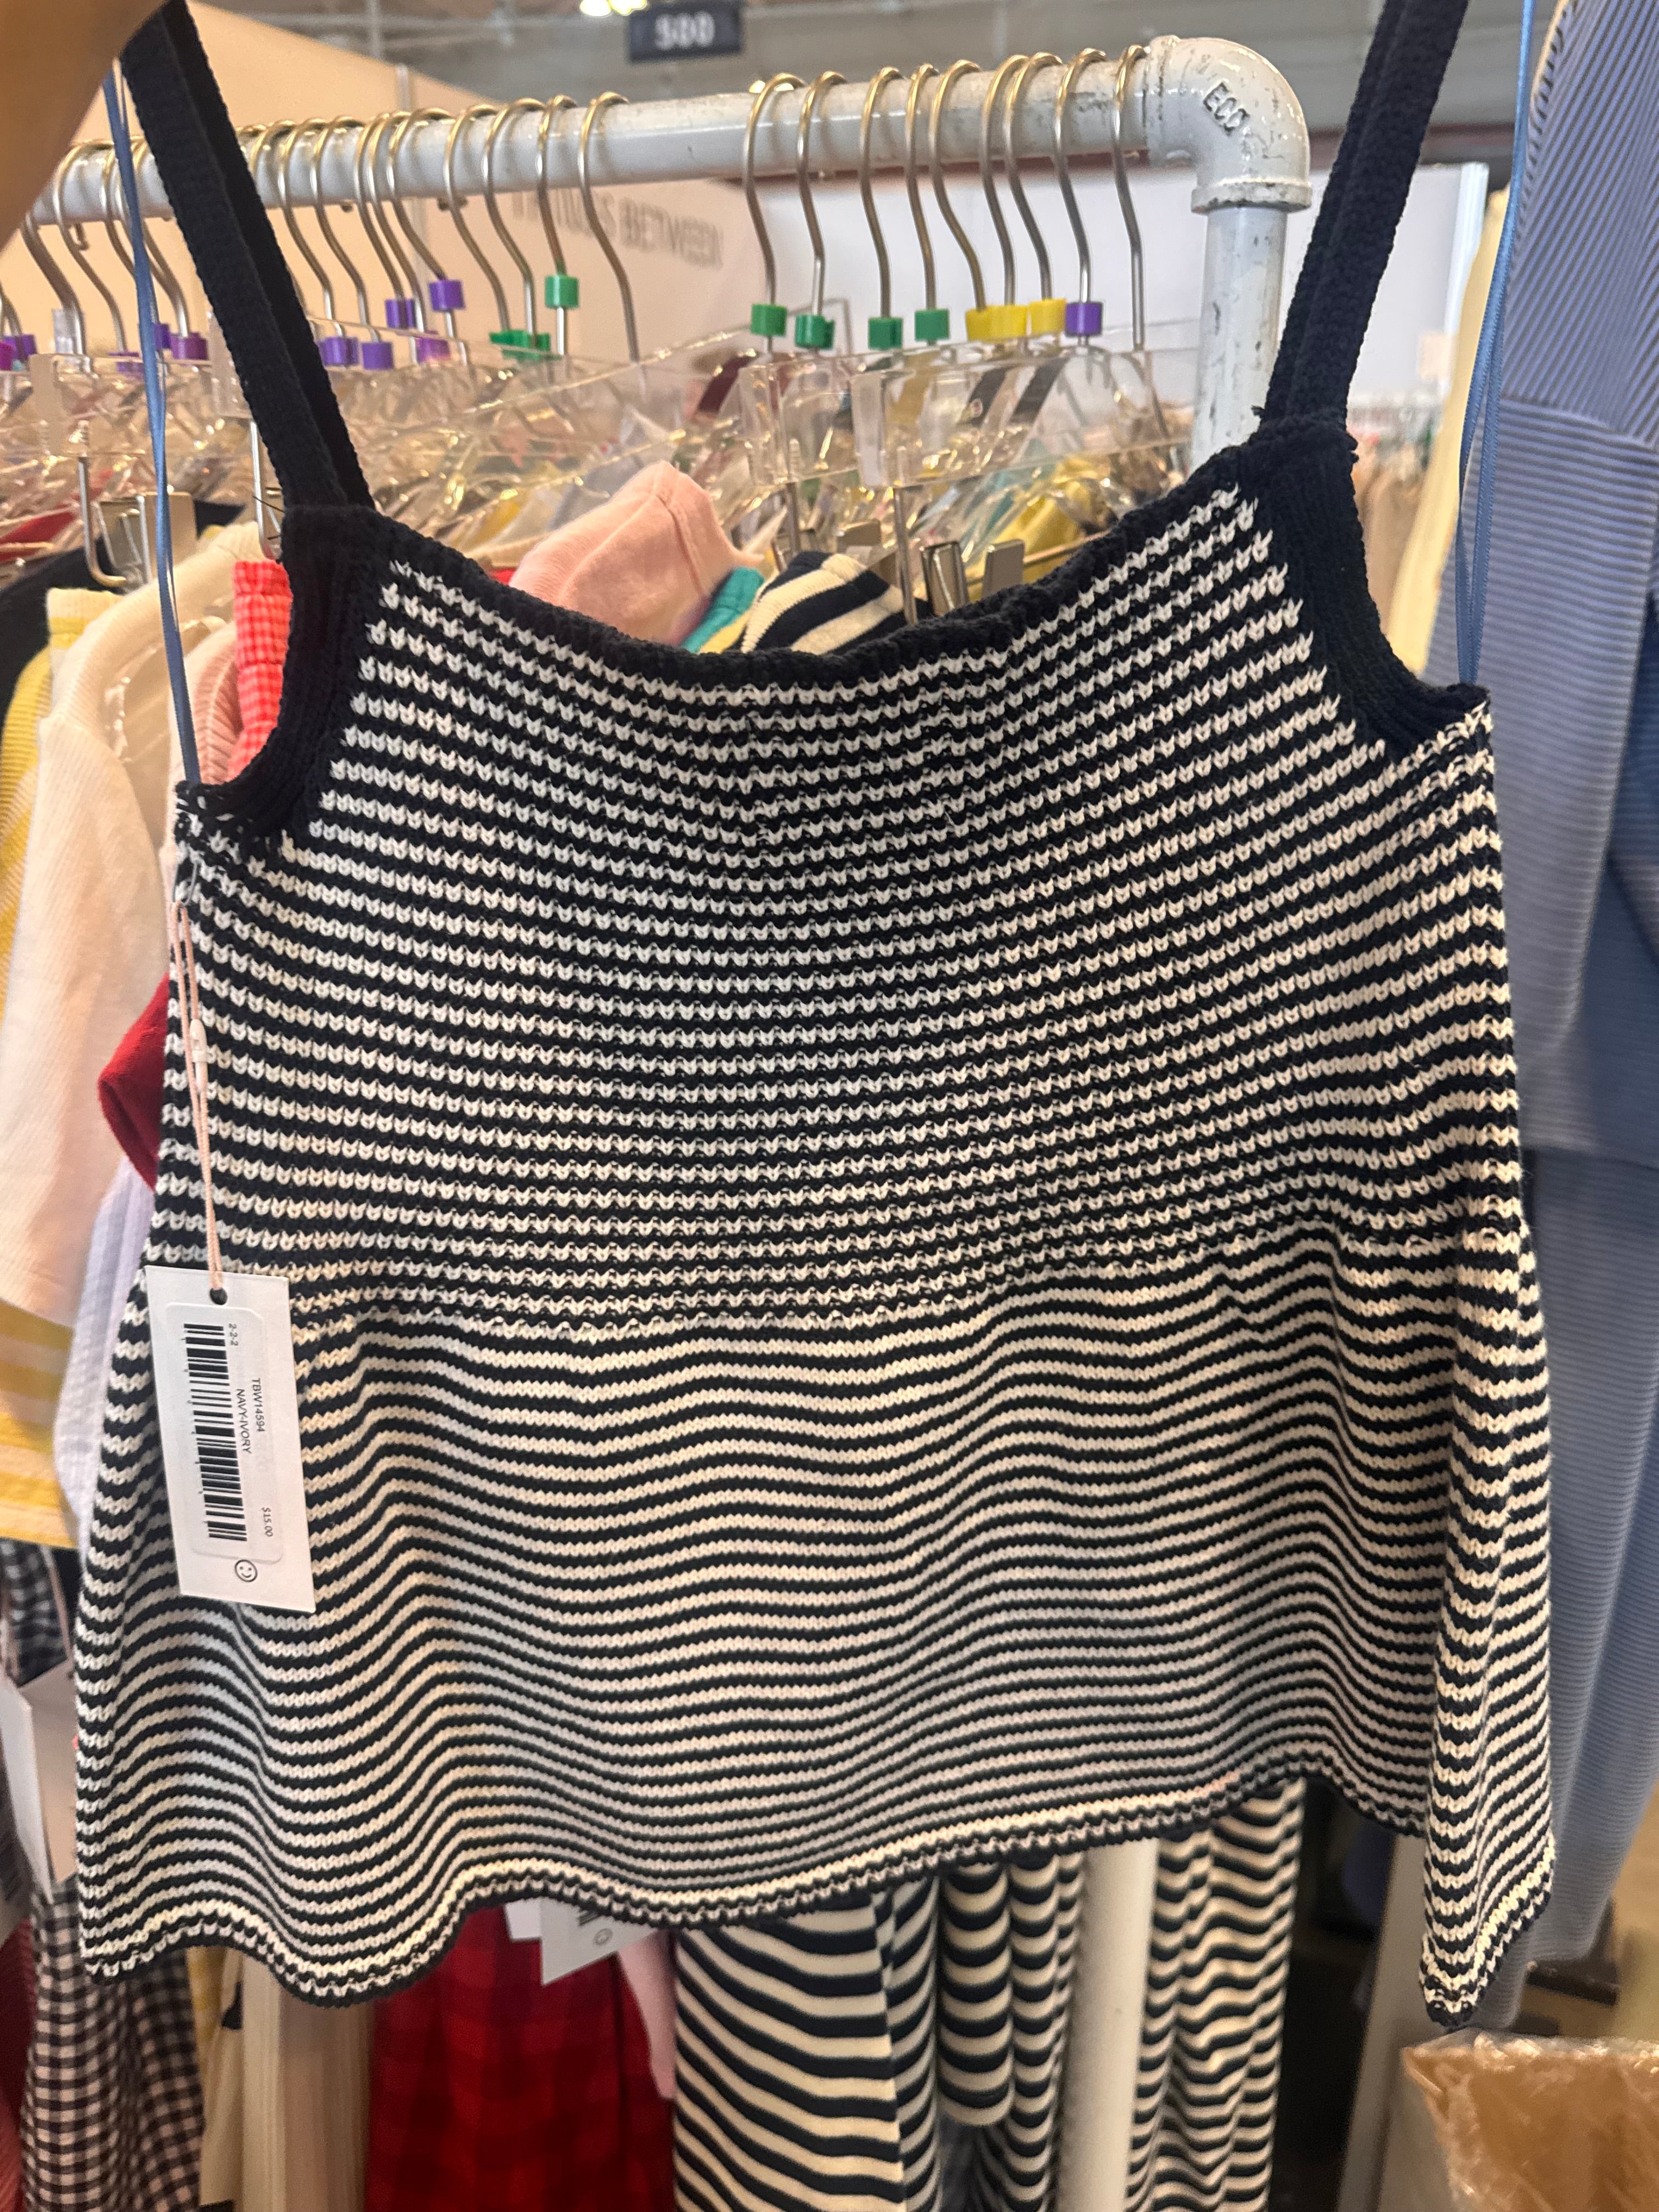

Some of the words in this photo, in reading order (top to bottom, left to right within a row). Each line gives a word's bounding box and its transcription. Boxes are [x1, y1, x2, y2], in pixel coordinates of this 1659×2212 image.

[228, 1323, 239, 1347] 2-2-2
[235, 1388, 252, 1455] NAVY-IVORY
[251, 1377, 266, 1433] TBW14594
[261, 1506, 274, 1538] $15.00
